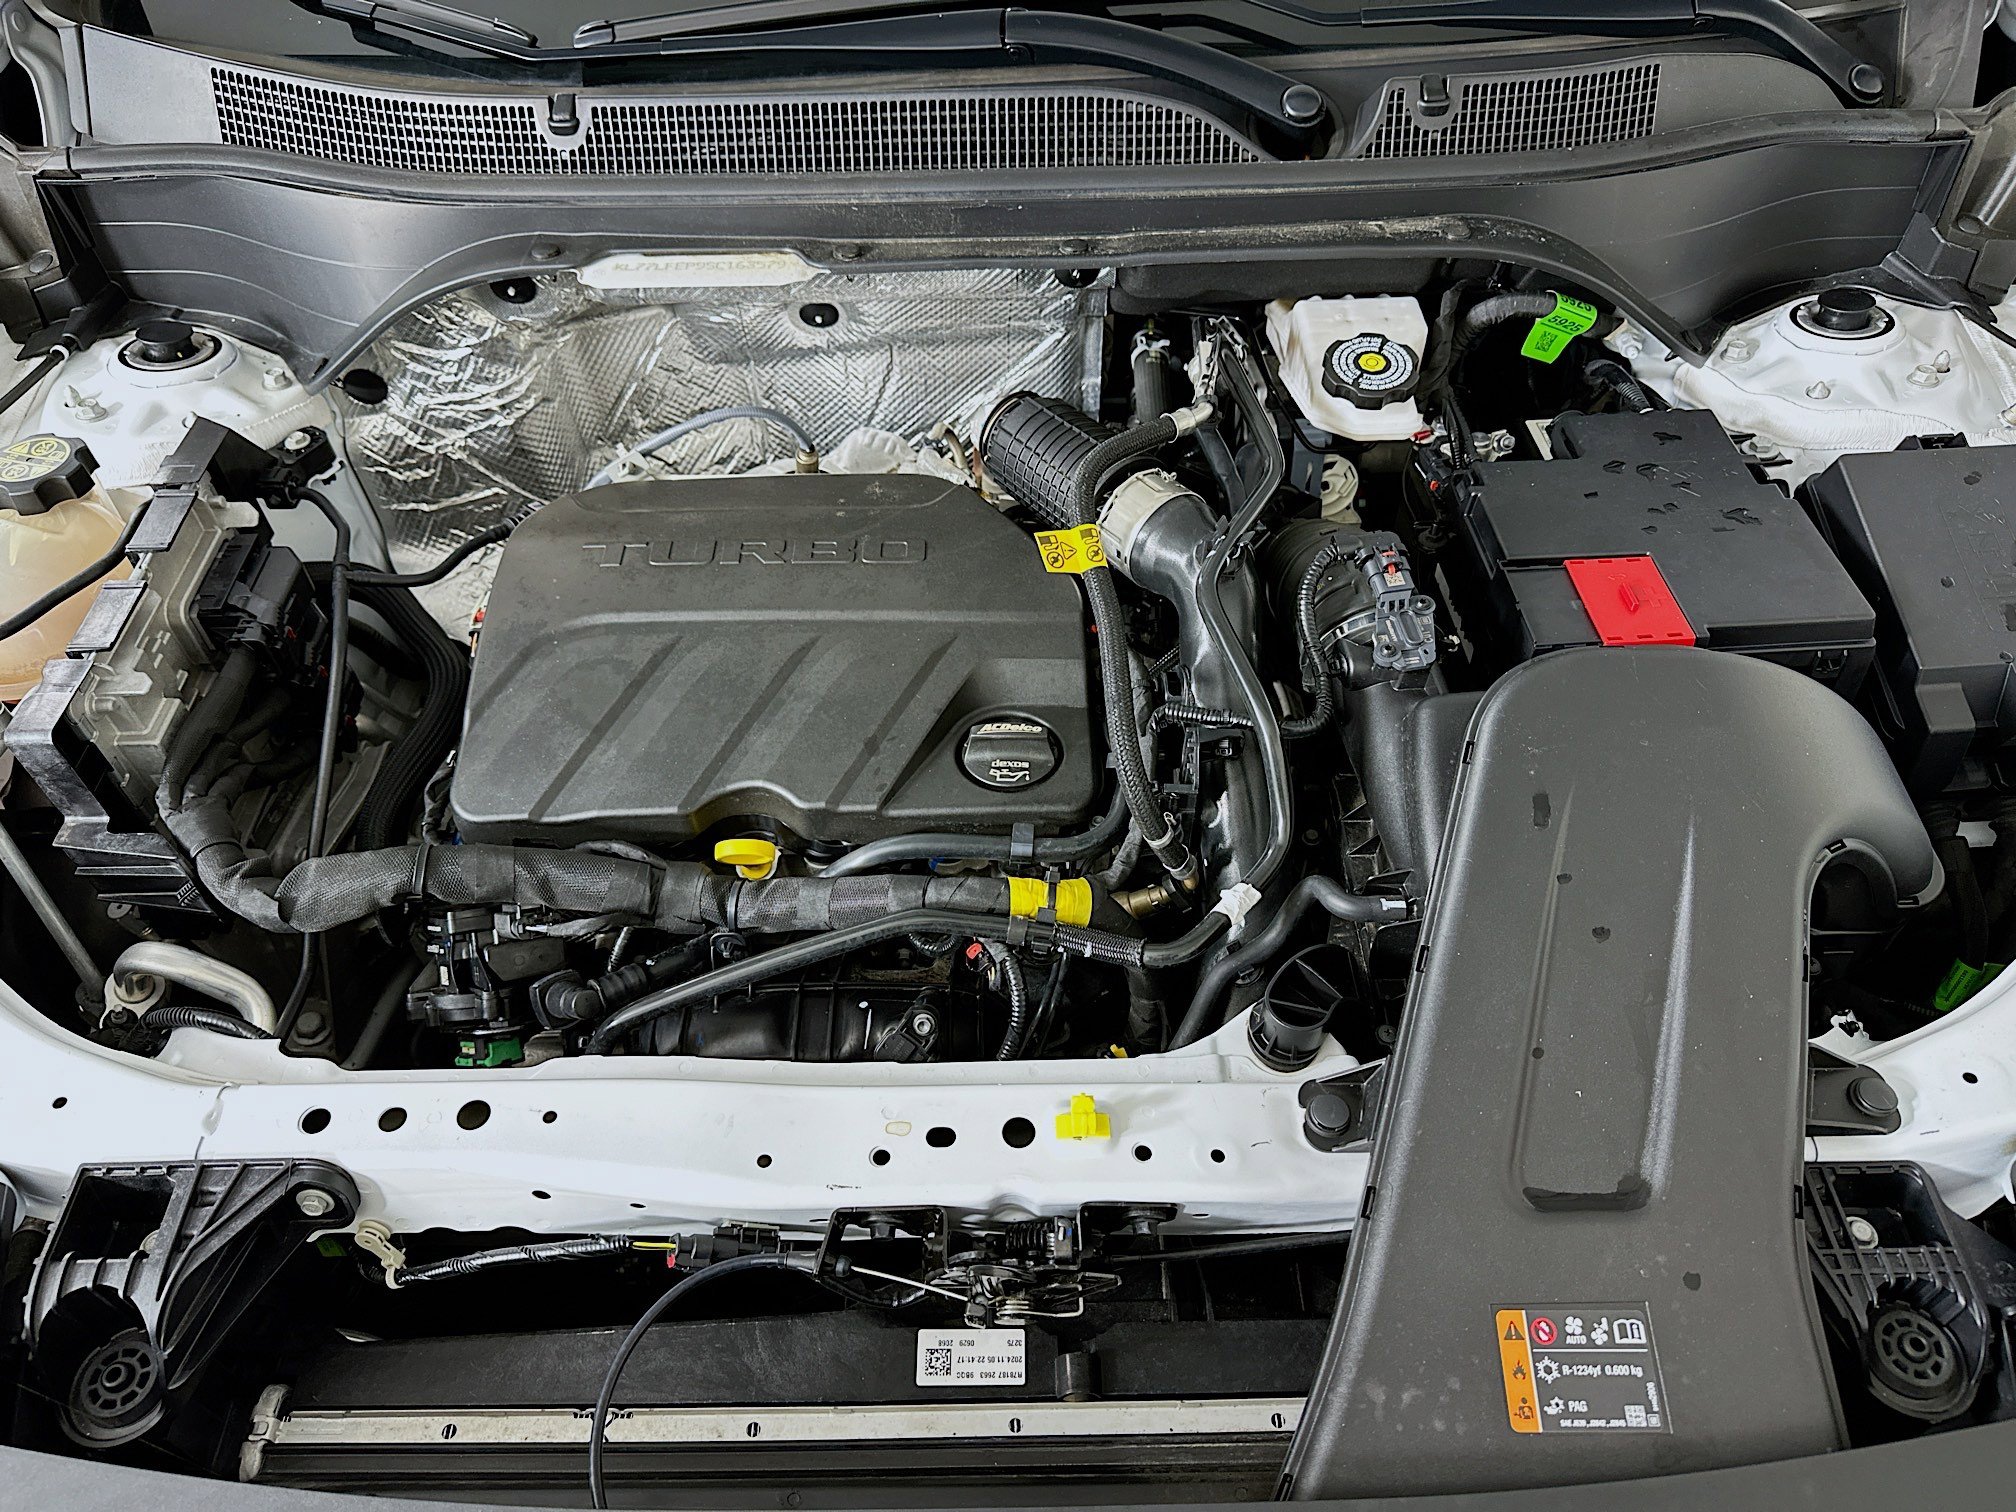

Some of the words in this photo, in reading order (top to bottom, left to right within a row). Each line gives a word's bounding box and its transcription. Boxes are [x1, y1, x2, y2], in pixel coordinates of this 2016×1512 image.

[1547, 315, 1584, 332] 5925
[582, 540, 927, 567] TURBO
[978, 723, 1043, 734] ACDelco
[991, 759, 1030, 768] dexos
[1007, 1339, 1022, 1347] 3275
[1566, 1335, 1587, 1345] AUTO
[1562, 1364, 1602, 1378] R-1234yf
[1604, 1364, 1630, 1376] 0.600
[1630, 1364, 1643, 1378] kg
[1568, 1400, 1589, 1413] PAG
